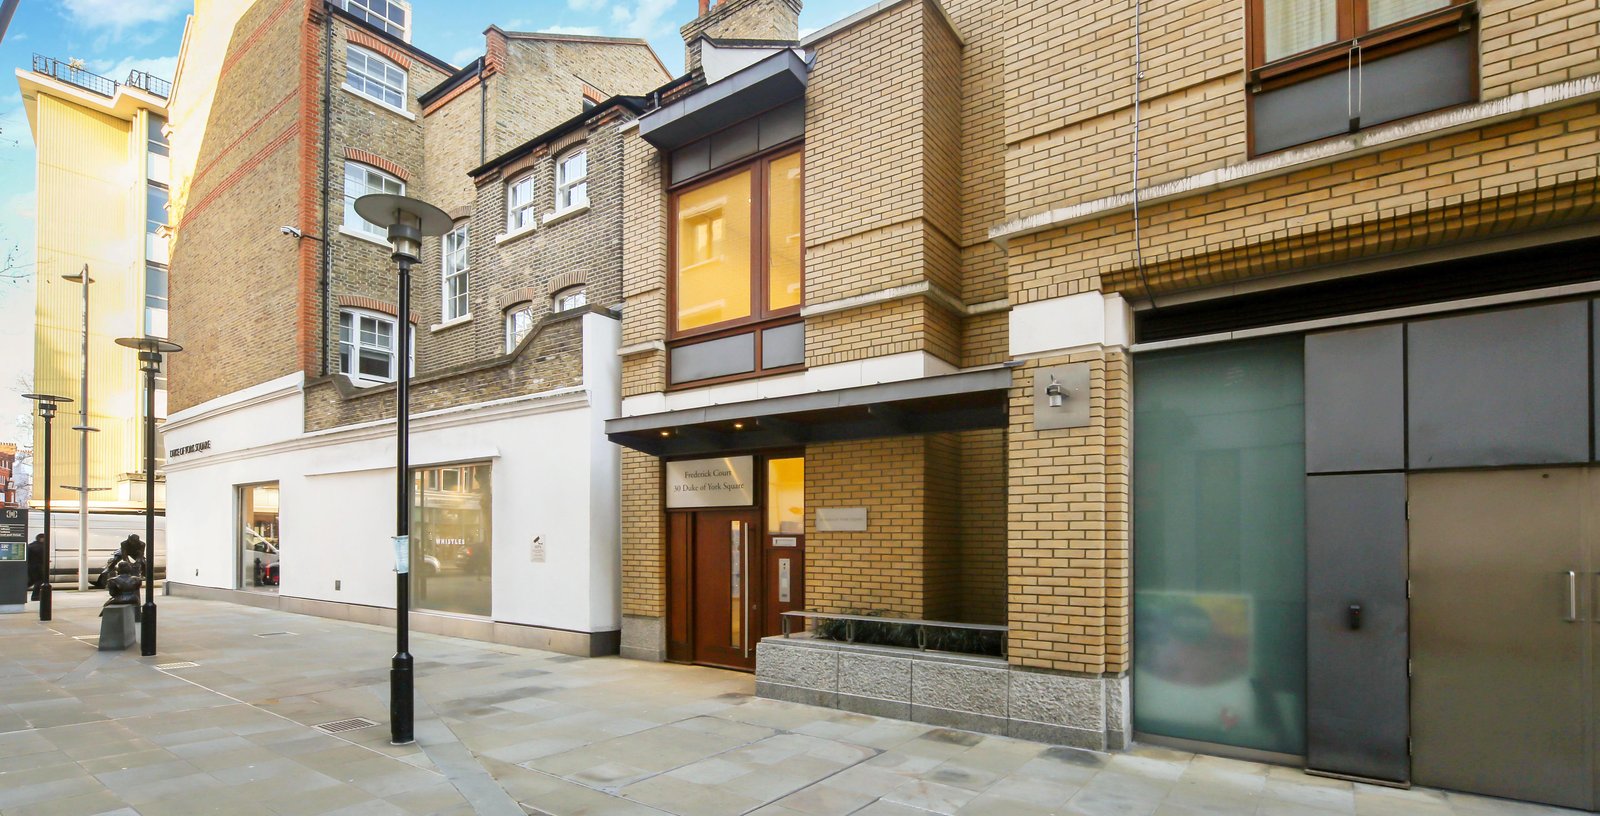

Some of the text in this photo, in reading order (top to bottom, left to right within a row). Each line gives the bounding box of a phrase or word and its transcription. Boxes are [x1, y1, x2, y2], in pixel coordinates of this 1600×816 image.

[684, 469, 732, 478] Frederick Court
[682, 483, 699, 492] Duke
[699, 483, 706, 491] of
[707, 482, 722, 490] York
[723, 482, 744, 491] Square
